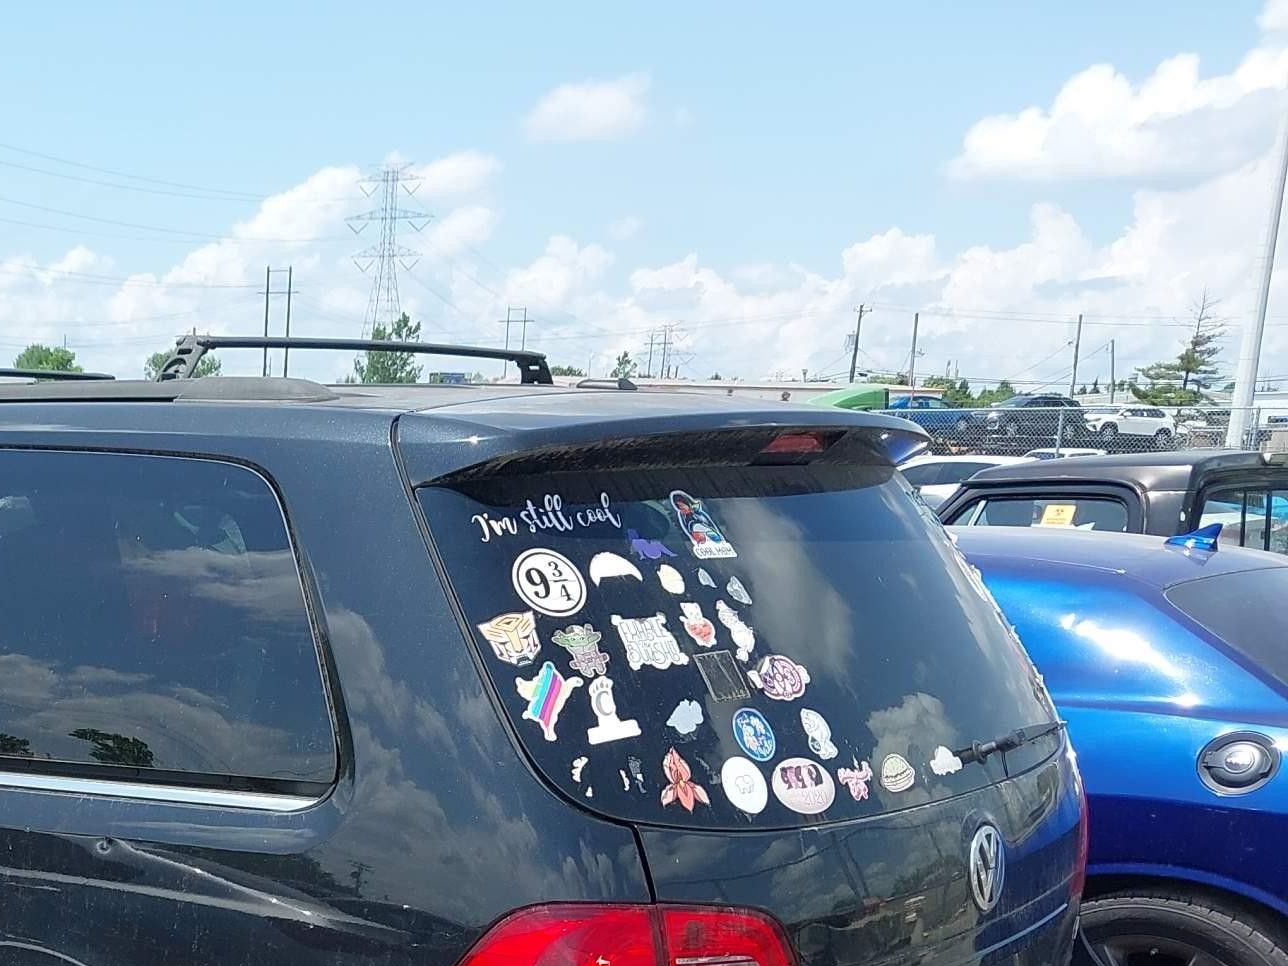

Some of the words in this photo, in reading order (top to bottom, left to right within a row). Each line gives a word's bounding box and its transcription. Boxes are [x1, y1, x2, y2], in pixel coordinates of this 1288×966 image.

[472, 513, 518, 542] I'm
[520, 494, 573, 533] still
[577, 492, 622, 528] cool
